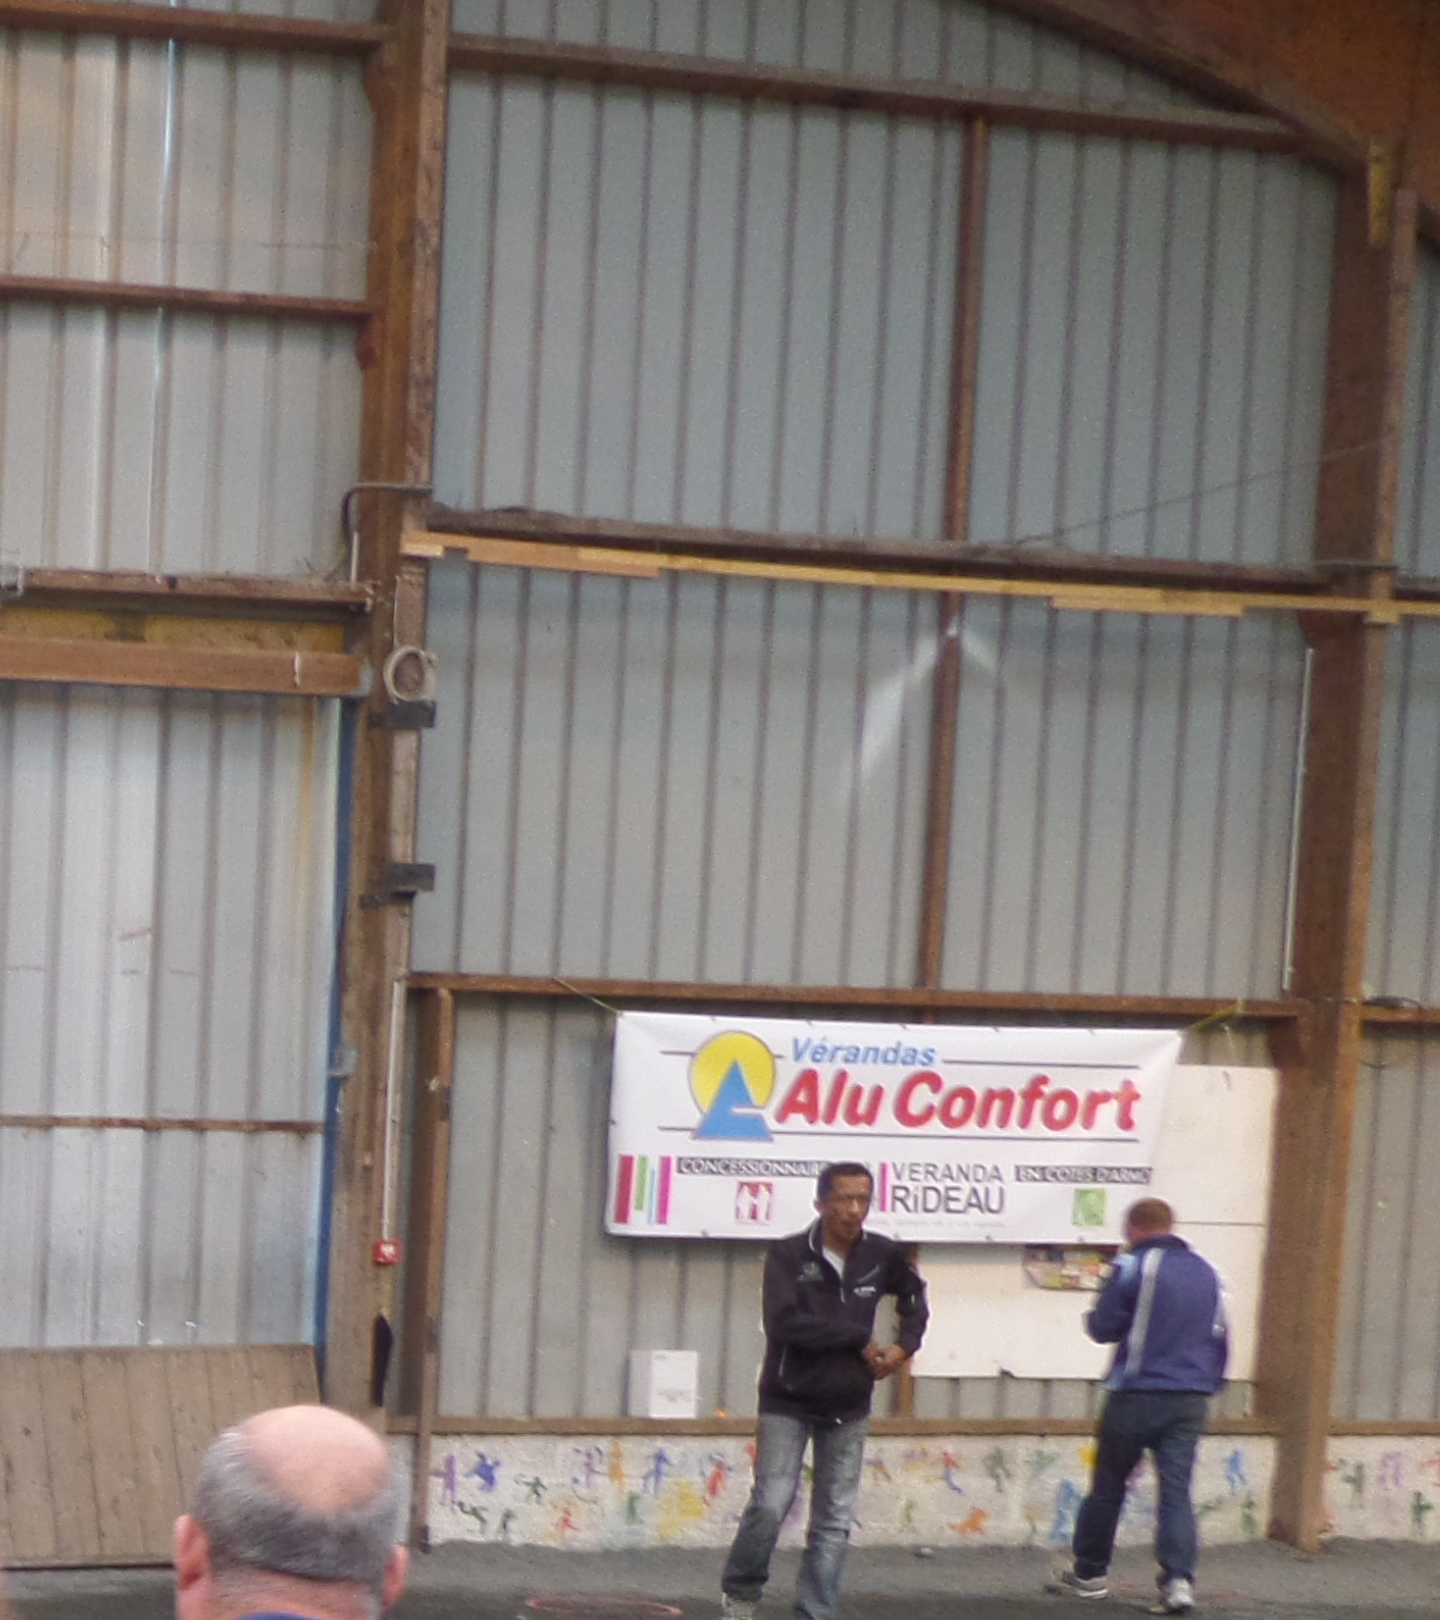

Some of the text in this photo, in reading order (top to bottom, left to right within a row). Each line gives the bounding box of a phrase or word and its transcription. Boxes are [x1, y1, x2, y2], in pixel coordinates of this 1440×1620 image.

[792, 1037, 937, 1067] Vérandas
[775, 1068, 1142, 1132] Alu Confort
[891, 1161, 1005, 1183] VERANDA
